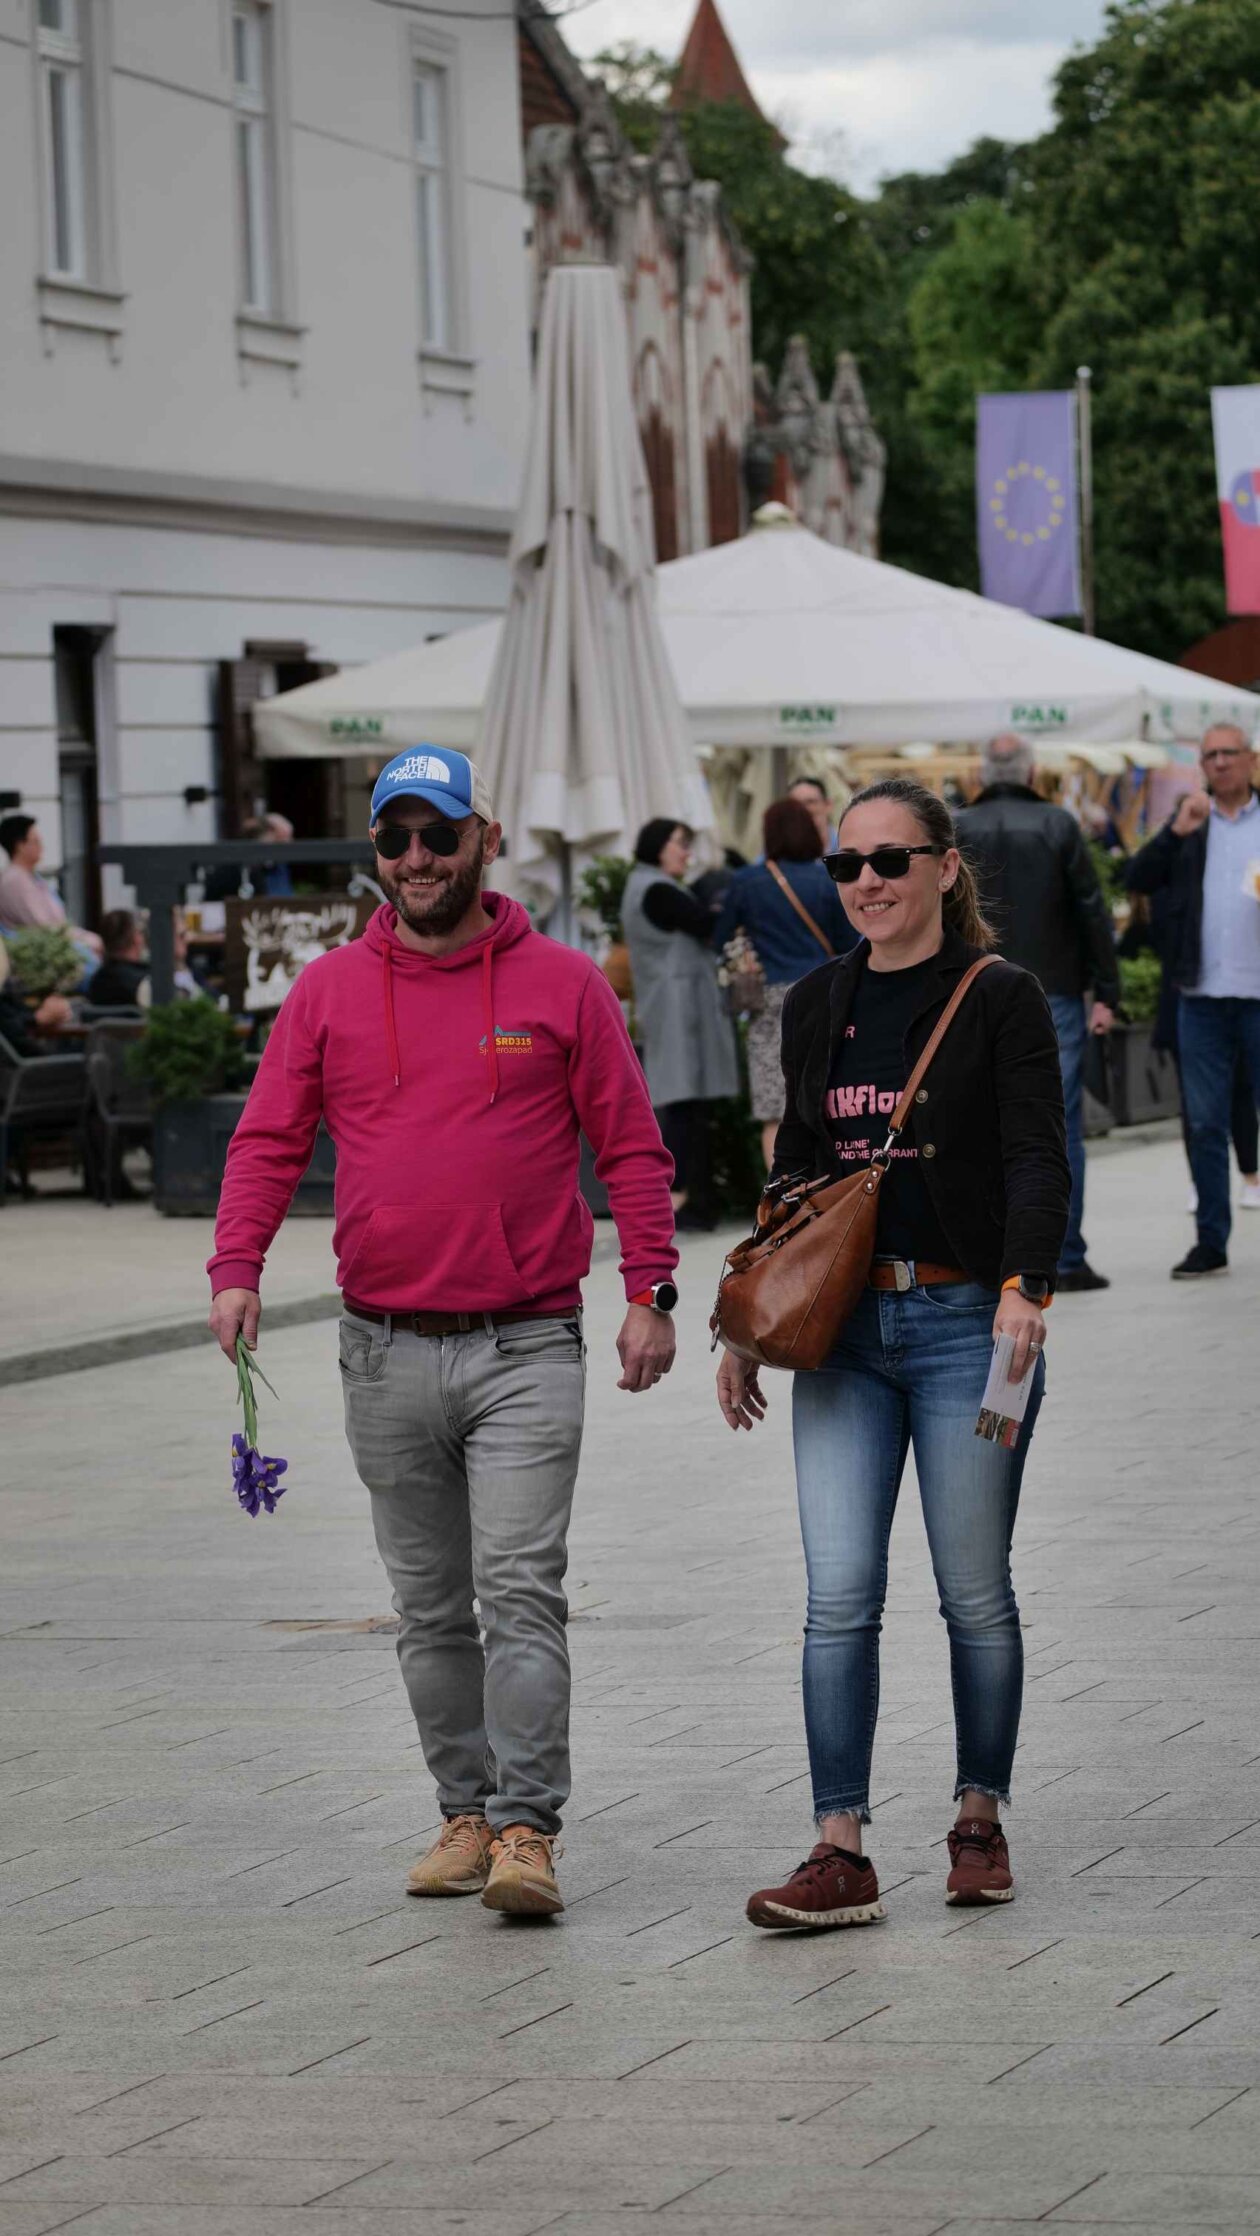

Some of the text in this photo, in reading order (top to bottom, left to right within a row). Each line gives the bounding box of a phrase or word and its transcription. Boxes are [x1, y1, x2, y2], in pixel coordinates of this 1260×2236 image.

[781, 706, 837, 723] PAN
[1011, 706, 1067, 723] PAN
[330, 717, 382, 734] PAN
[404, 755, 429, 767] THE
[386, 762, 427, 781] NORTH
[393, 771, 425, 784] FACE
[495, 1037, 532, 1046] SRD315
[479, 1046, 533, 1057] Sjerozapad
